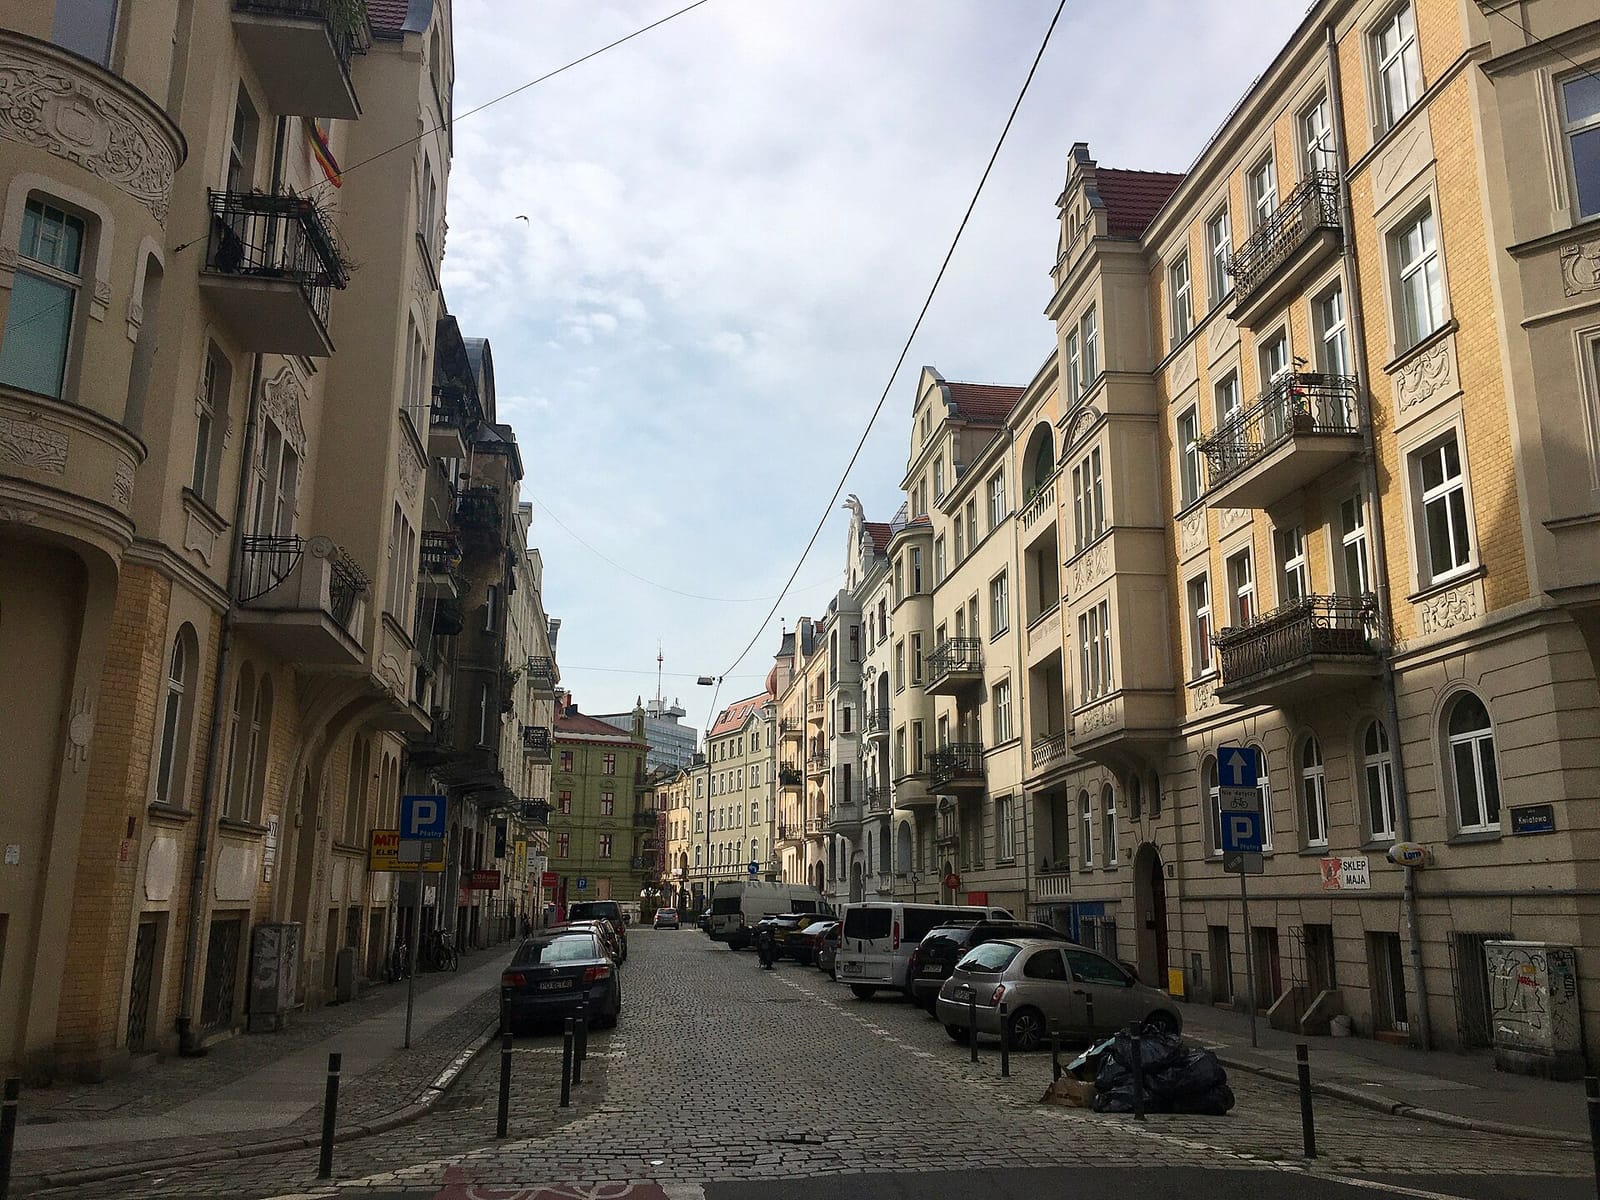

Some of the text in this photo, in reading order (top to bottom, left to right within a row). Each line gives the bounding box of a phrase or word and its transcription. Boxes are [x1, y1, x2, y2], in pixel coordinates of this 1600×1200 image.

[410, 800, 437, 834] P
[1518, 815, 1547, 825] Kwiatowa
[1230, 816, 1253, 847] P
[1343, 860, 1365, 871] SKLEP
[1346, 874, 1366, 885] MAJA
